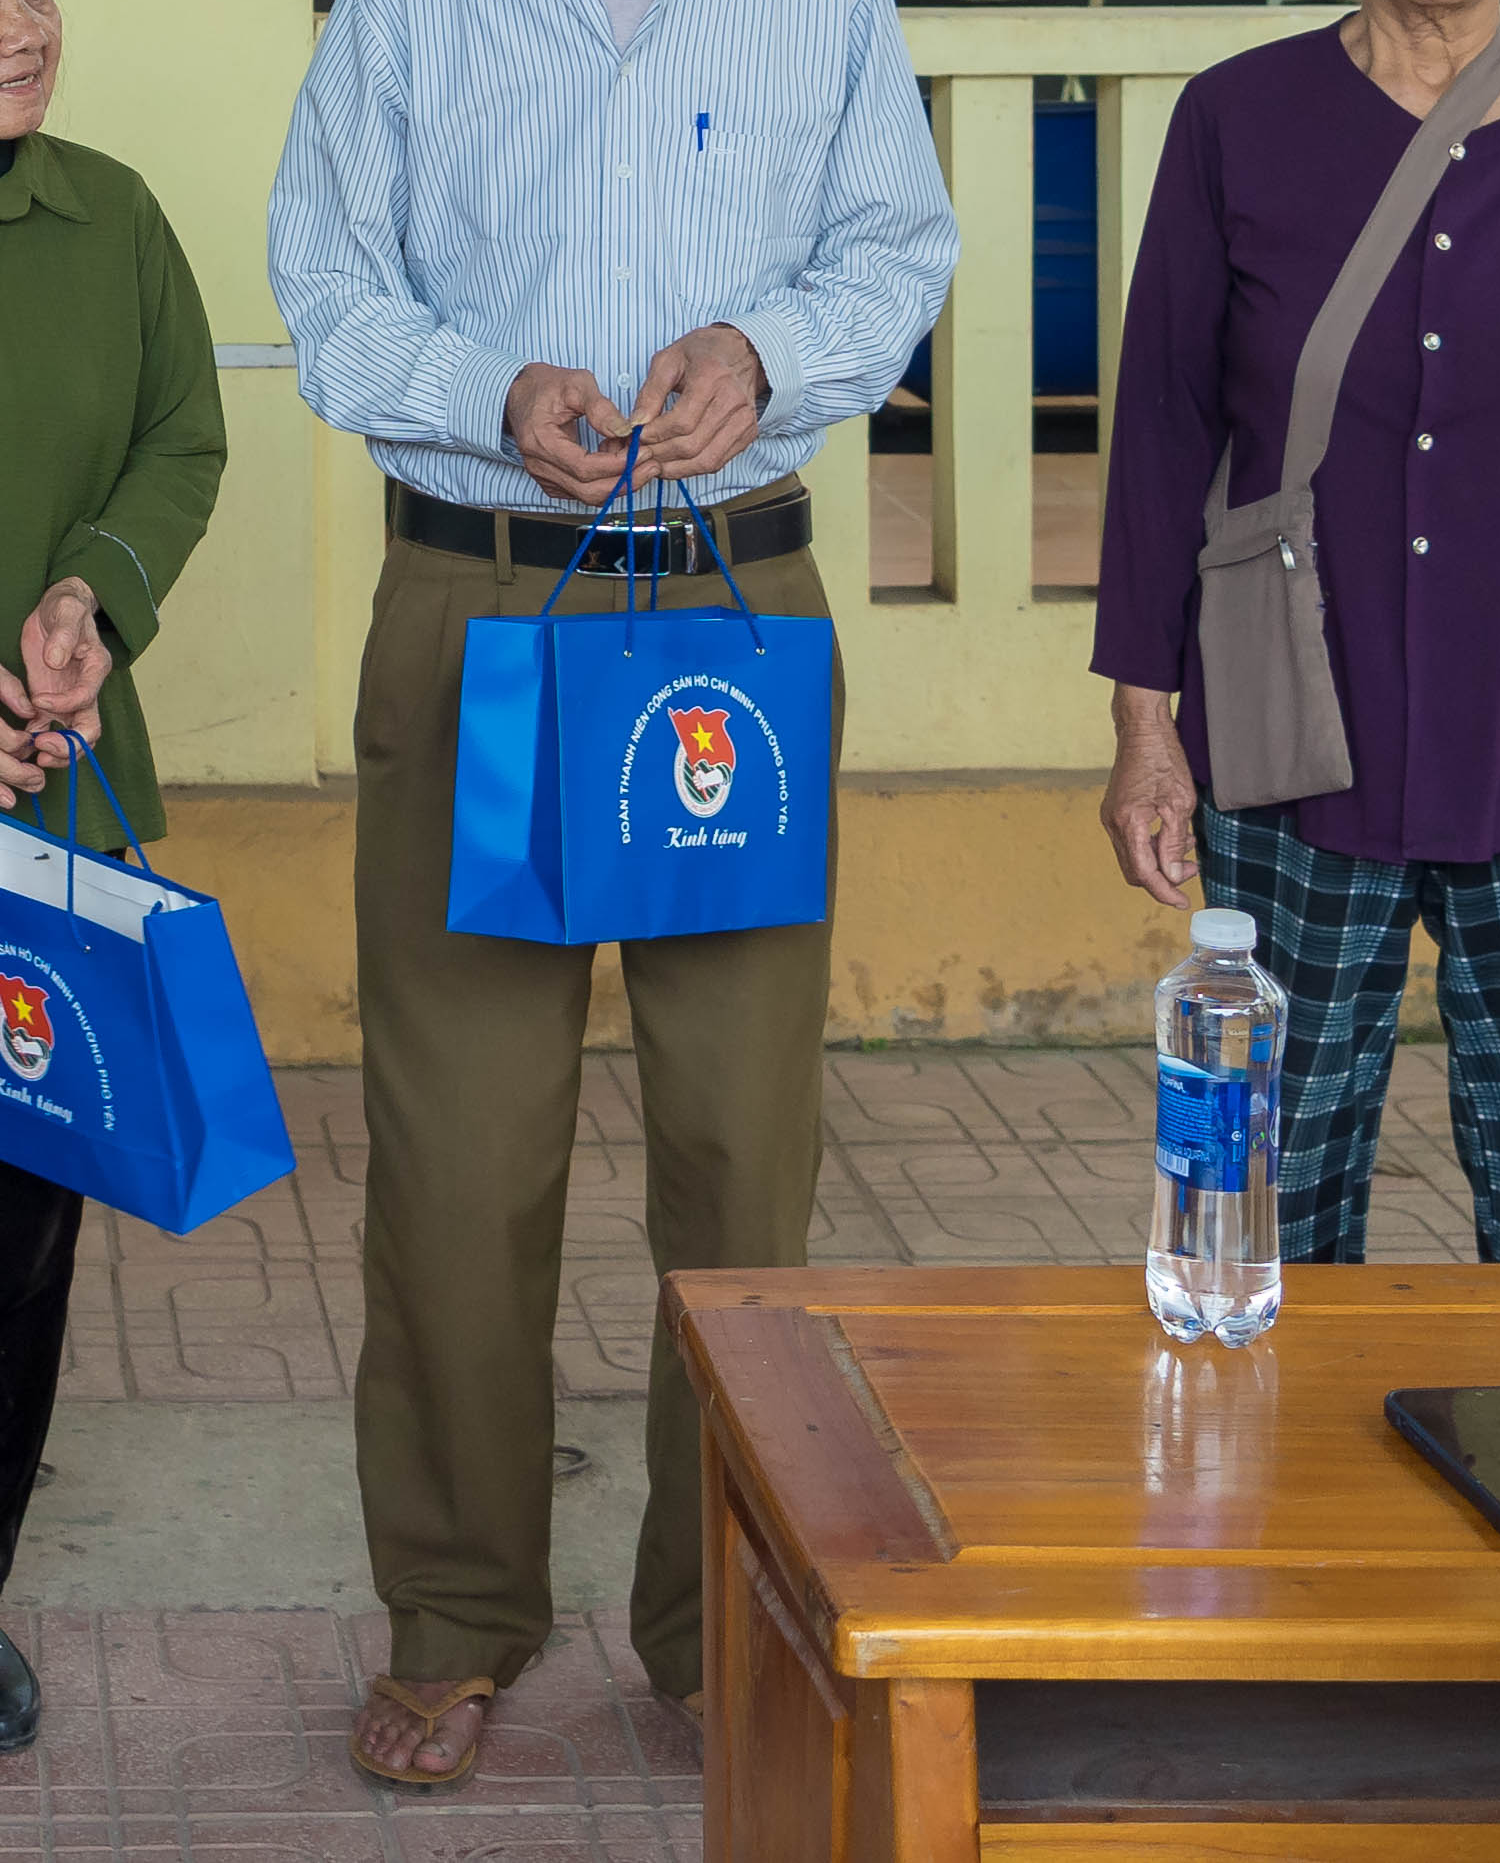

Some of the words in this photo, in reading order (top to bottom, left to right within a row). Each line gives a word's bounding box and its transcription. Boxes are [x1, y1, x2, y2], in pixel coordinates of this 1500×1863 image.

[620, 745, 637, 795] THANH
[631, 710, 650, 743] NIÊN
[710, 677, 728, 693] CHÍ
[729, 685, 755, 713] MINH
[712, 826, 747, 850] tặng
